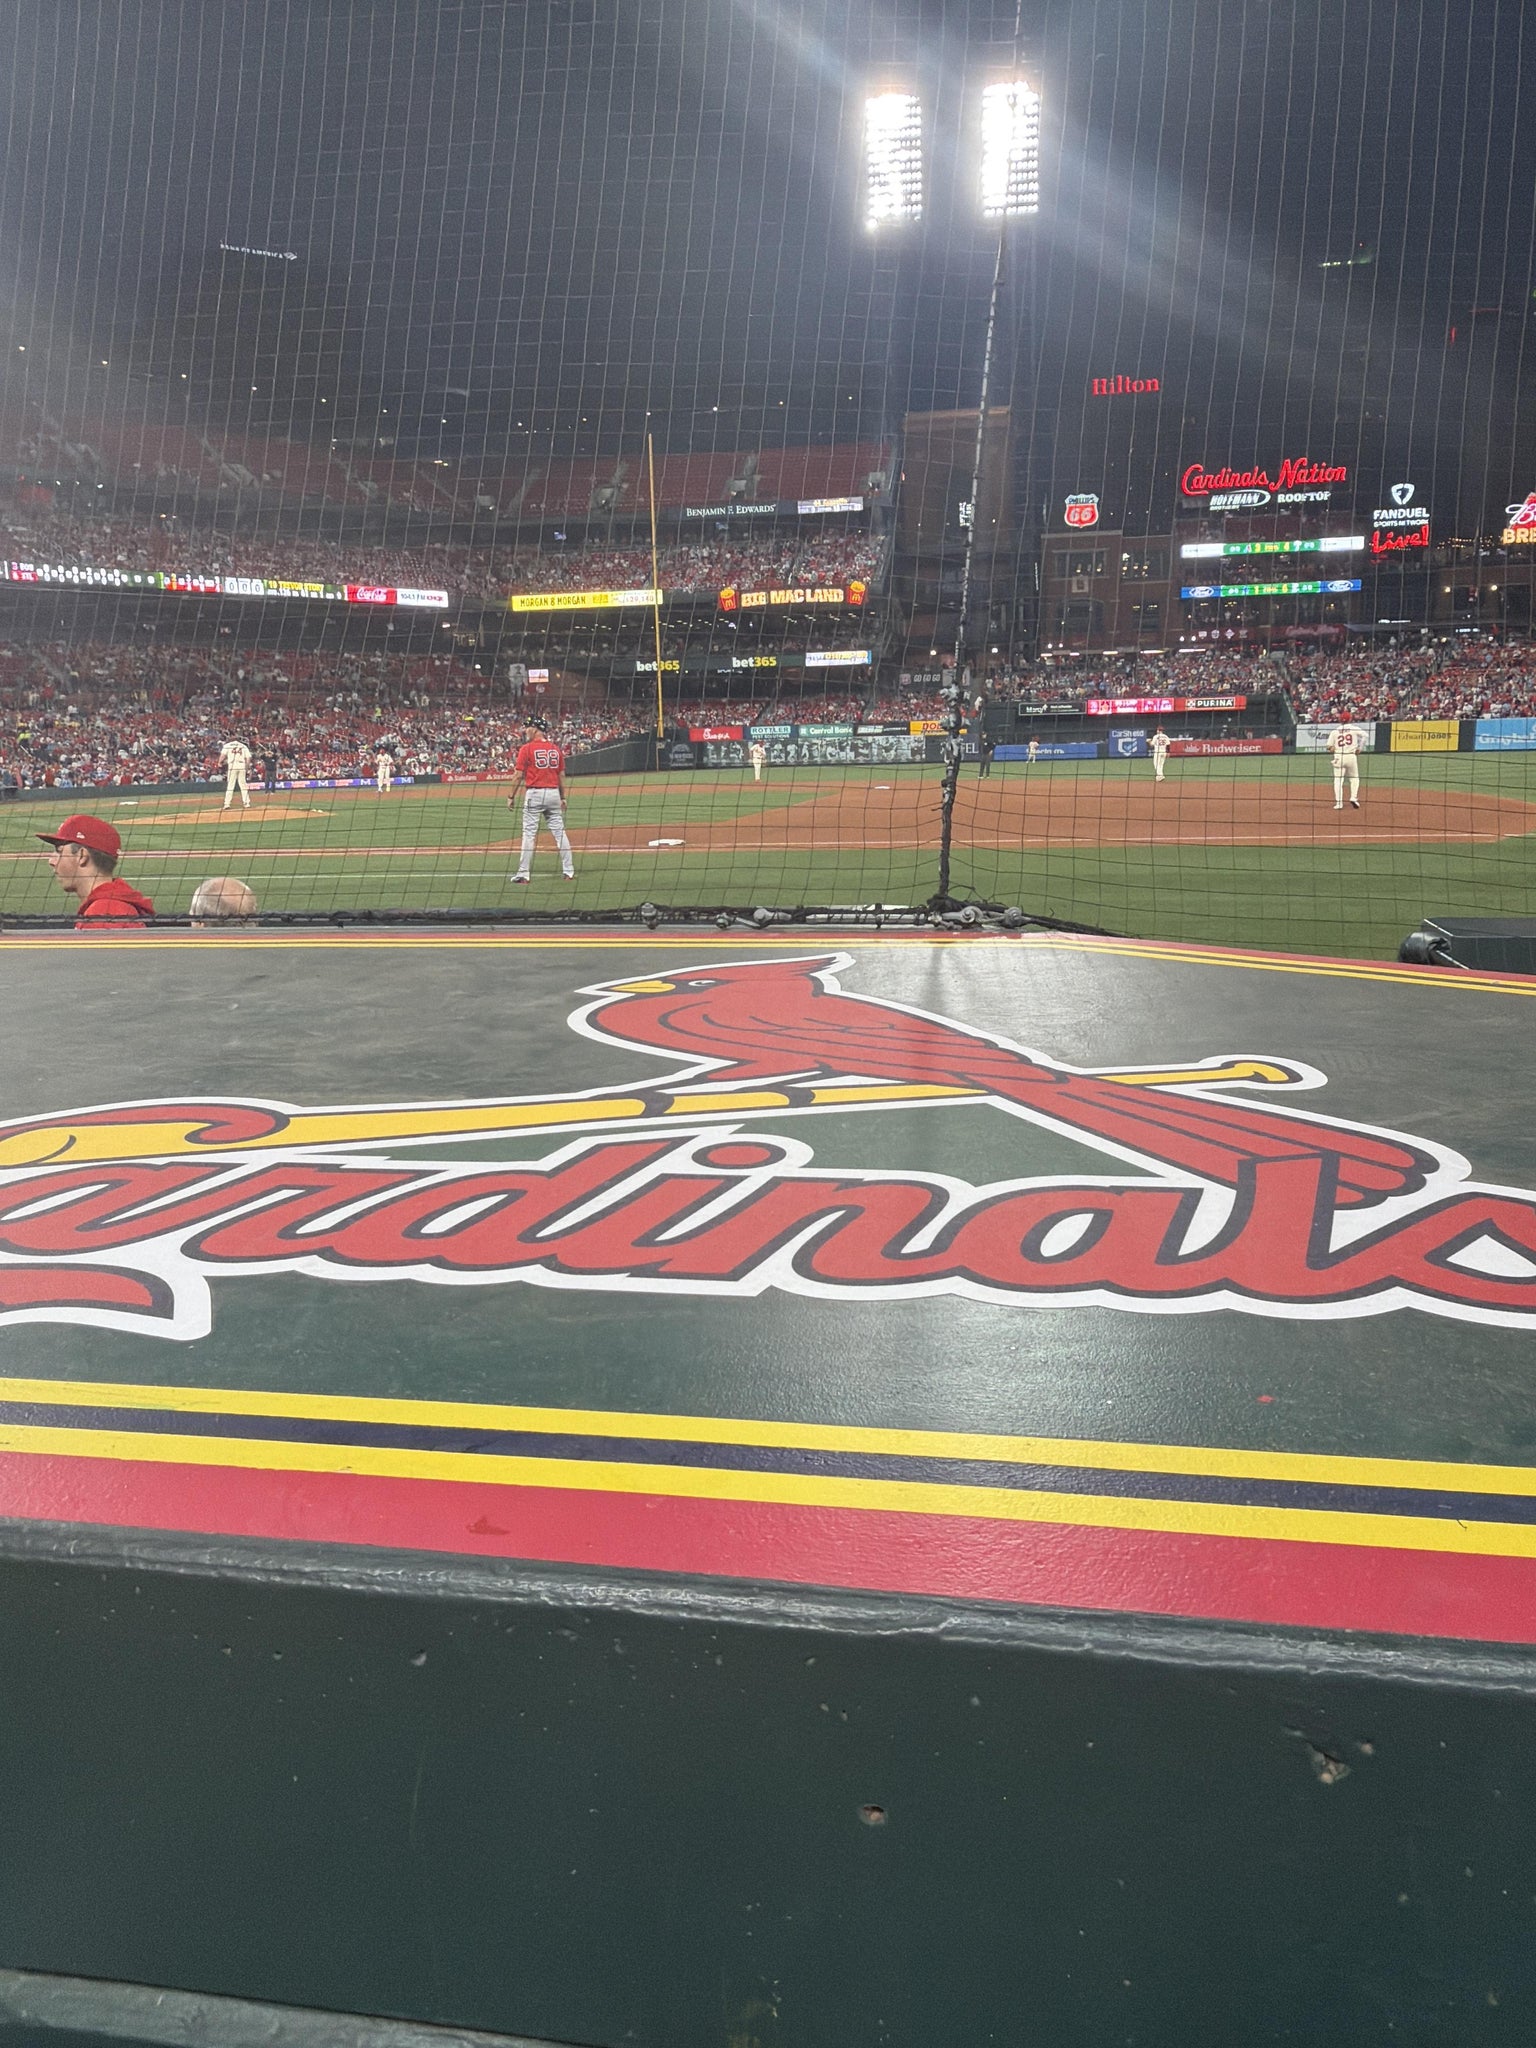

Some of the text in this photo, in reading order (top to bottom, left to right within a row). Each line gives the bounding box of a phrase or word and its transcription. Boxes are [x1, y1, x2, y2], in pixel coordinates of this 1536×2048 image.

[1092, 374, 1160, 395] Hilton
[1181, 457, 1347, 495] Cardinals Nation
[1277, 491, 1332, 503] ROOFTOP
[686, 507, 726, 517] BENJAMIN
[736, 503, 774, 513] EDWARDS
[1069, 507, 1093, 521] 66
[1373, 508, 1430, 520] FANDUEL
[1371, 525, 1430, 553] Live!
[1328, 580, 1352, 592] Ford
[520, 598, 548, 607] MORGAN
[557, 596, 586, 605] MORGAN
[741, 588, 844, 607] BIG MAC LAND
[732, 657, 777, 667] bet365
[1196, 699, 1233, 708] PURINA
[809, 727, 834, 735] Central
[1337, 734, 1353, 747] 29
[1202, 744, 1261, 754] Budweiser
[535, 750, 559, 768] 58
